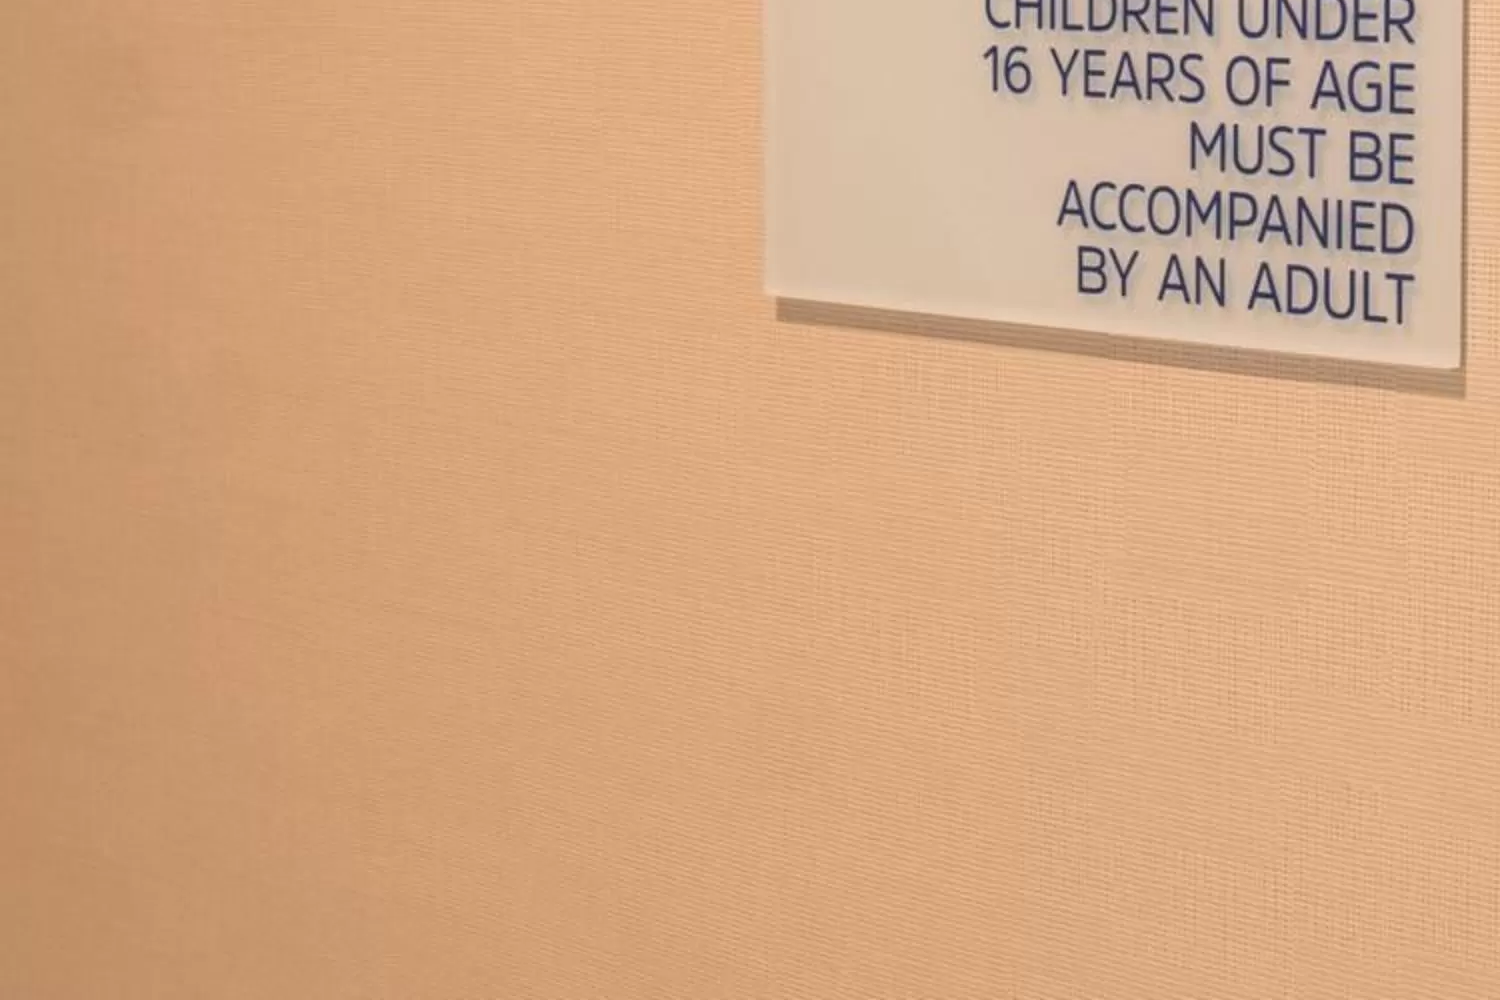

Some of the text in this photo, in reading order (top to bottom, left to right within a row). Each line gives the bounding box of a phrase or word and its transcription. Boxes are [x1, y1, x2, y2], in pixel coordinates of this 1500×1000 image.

[983, 45, 1416, 115] 16 YEARS OF AGE
[1189, 120, 1415, 186] MUST BE
[1056, 179, 1415, 255] ACCOMPANIED
[1077, 245, 1416, 325] BY AN ADULT
